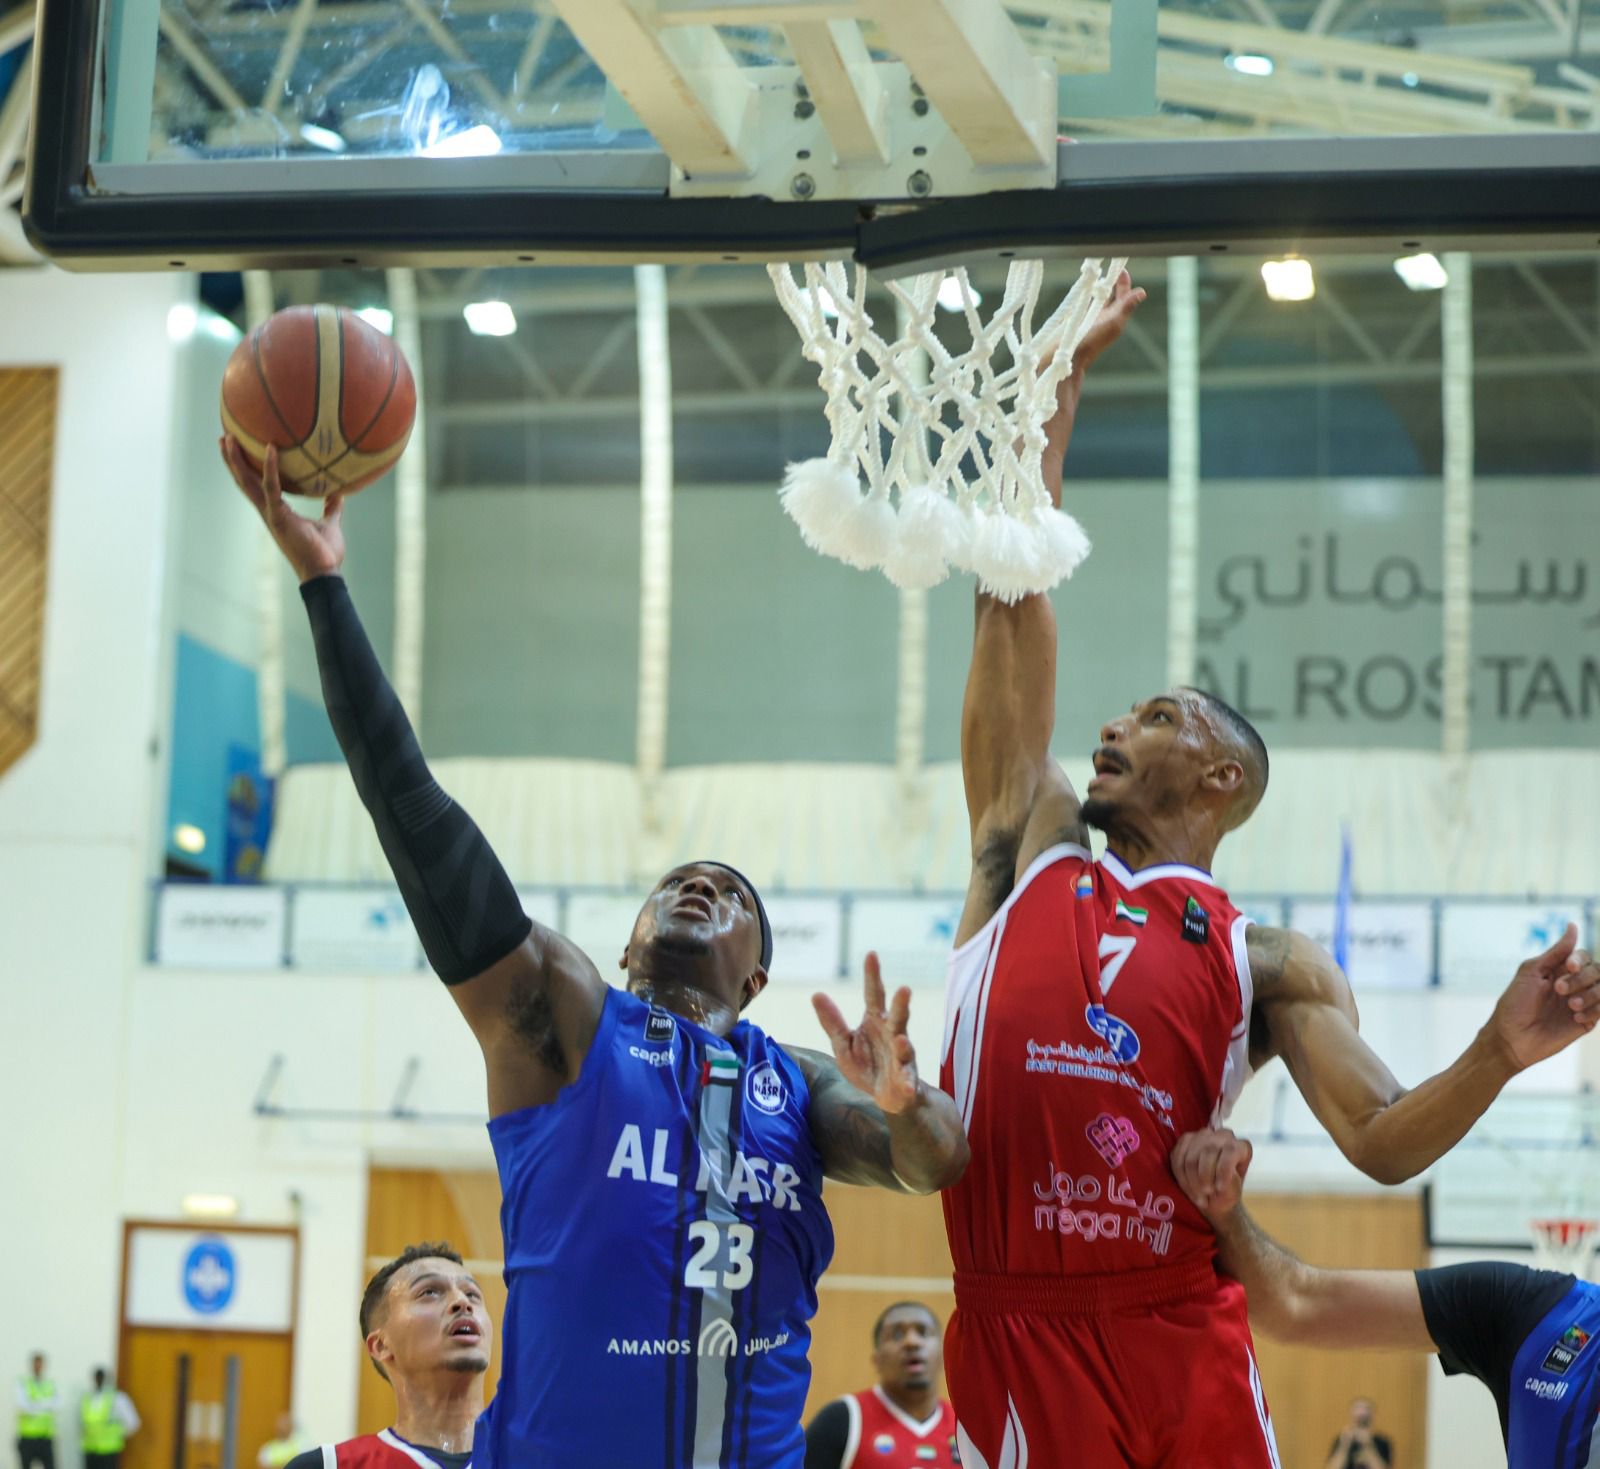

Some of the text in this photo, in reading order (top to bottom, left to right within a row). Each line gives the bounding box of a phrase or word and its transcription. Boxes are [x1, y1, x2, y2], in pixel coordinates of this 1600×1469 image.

[1098, 932, 1137, 997] 7
[651, 1017, 672, 1029] FIBA
[606, 1123, 678, 1187] AL
[1034, 1205, 1120, 1243] mega
[683, 1220, 755, 1290] 23
[606, 1338, 691, 1355] AMANOS
[1552, 1347, 1572, 1363] FIBA
[1525, 1377, 1569, 1399] capelli
